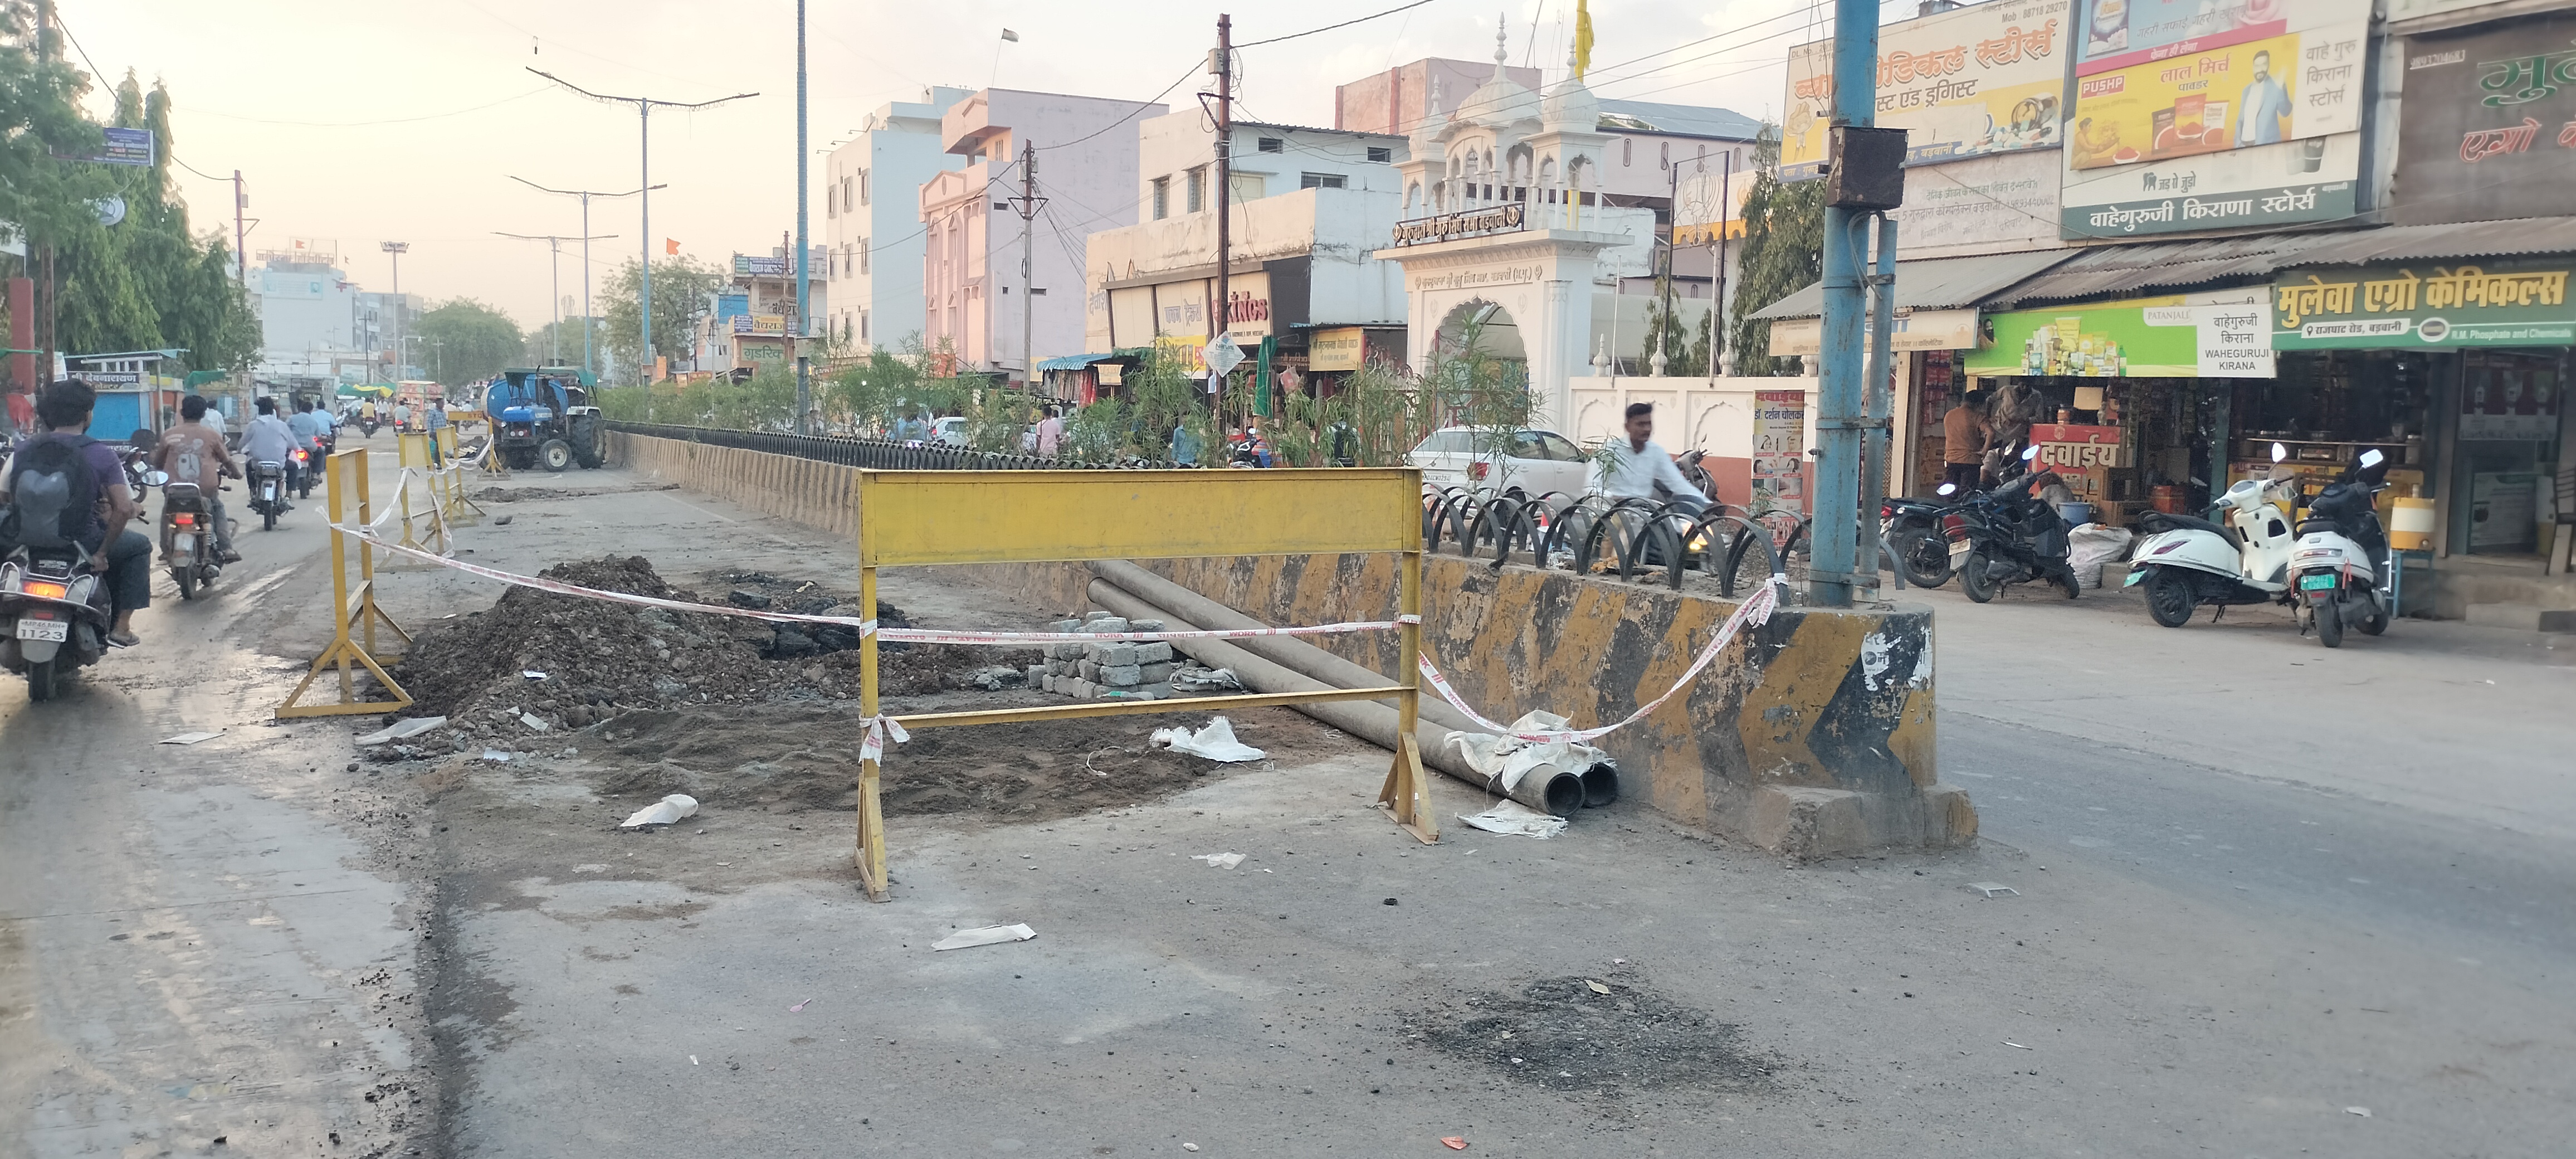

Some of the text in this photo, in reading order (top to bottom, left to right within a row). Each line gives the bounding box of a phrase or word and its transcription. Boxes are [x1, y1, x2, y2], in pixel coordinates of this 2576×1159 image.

[2002, 1, 2067, 23] Mob 88718 29270
[2137, 22, 2159, 39] गहरी
[2192, 8, 2216, 26] गहरी
[1976, 18, 2058, 69] स्टोर्स
[2306, 40, 2357, 61] वाहे गुरु
[2160, 53, 2231, 83] लाल मिर्च
[2306, 65, 2353, 85] किराना
[1900, 87, 1922, 108] एंड
[1925, 79, 1978, 108] ड्रगिस्ट
[2083, 78, 2123, 94] PUSHP
[2178, 80, 2208, 91] पावडर
[2309, 84, 2346, 107] स्टोर्स
[2460, 117, 2541, 163] एग्रो
[1921, 143, 1953, 159] बड़वानी
[1784, 168, 1796, 177] पता
[2090, 200, 2173, 232] वाहेगुरुजी
[2183, 198, 2253, 220] किराणा
[2261, 187, 2315, 213] स्टोर्स
[2279, 266, 2569, 328] मुलेवा एग्रो केमिकल्स
[2148, 311, 2190, 321] PATANJALI
[2213, 313, 2258, 330] वाहेगुरुजी
[2369, 320, 2402, 333] बड़वानी
[2221, 330, 2254, 344] किराना
[2470, 330, 2511, 341] Phosphate
[2512, 330, 2528, 338] and
[2205, 349, 2269, 358] WAHEGURUJI
[2219, 362, 2256, 370] KIRANA
[1764, 407, 1780, 420] दर्शन
[2040, 434, 2119, 471] दवाईय
[21, 629, 64, 640] 1123
